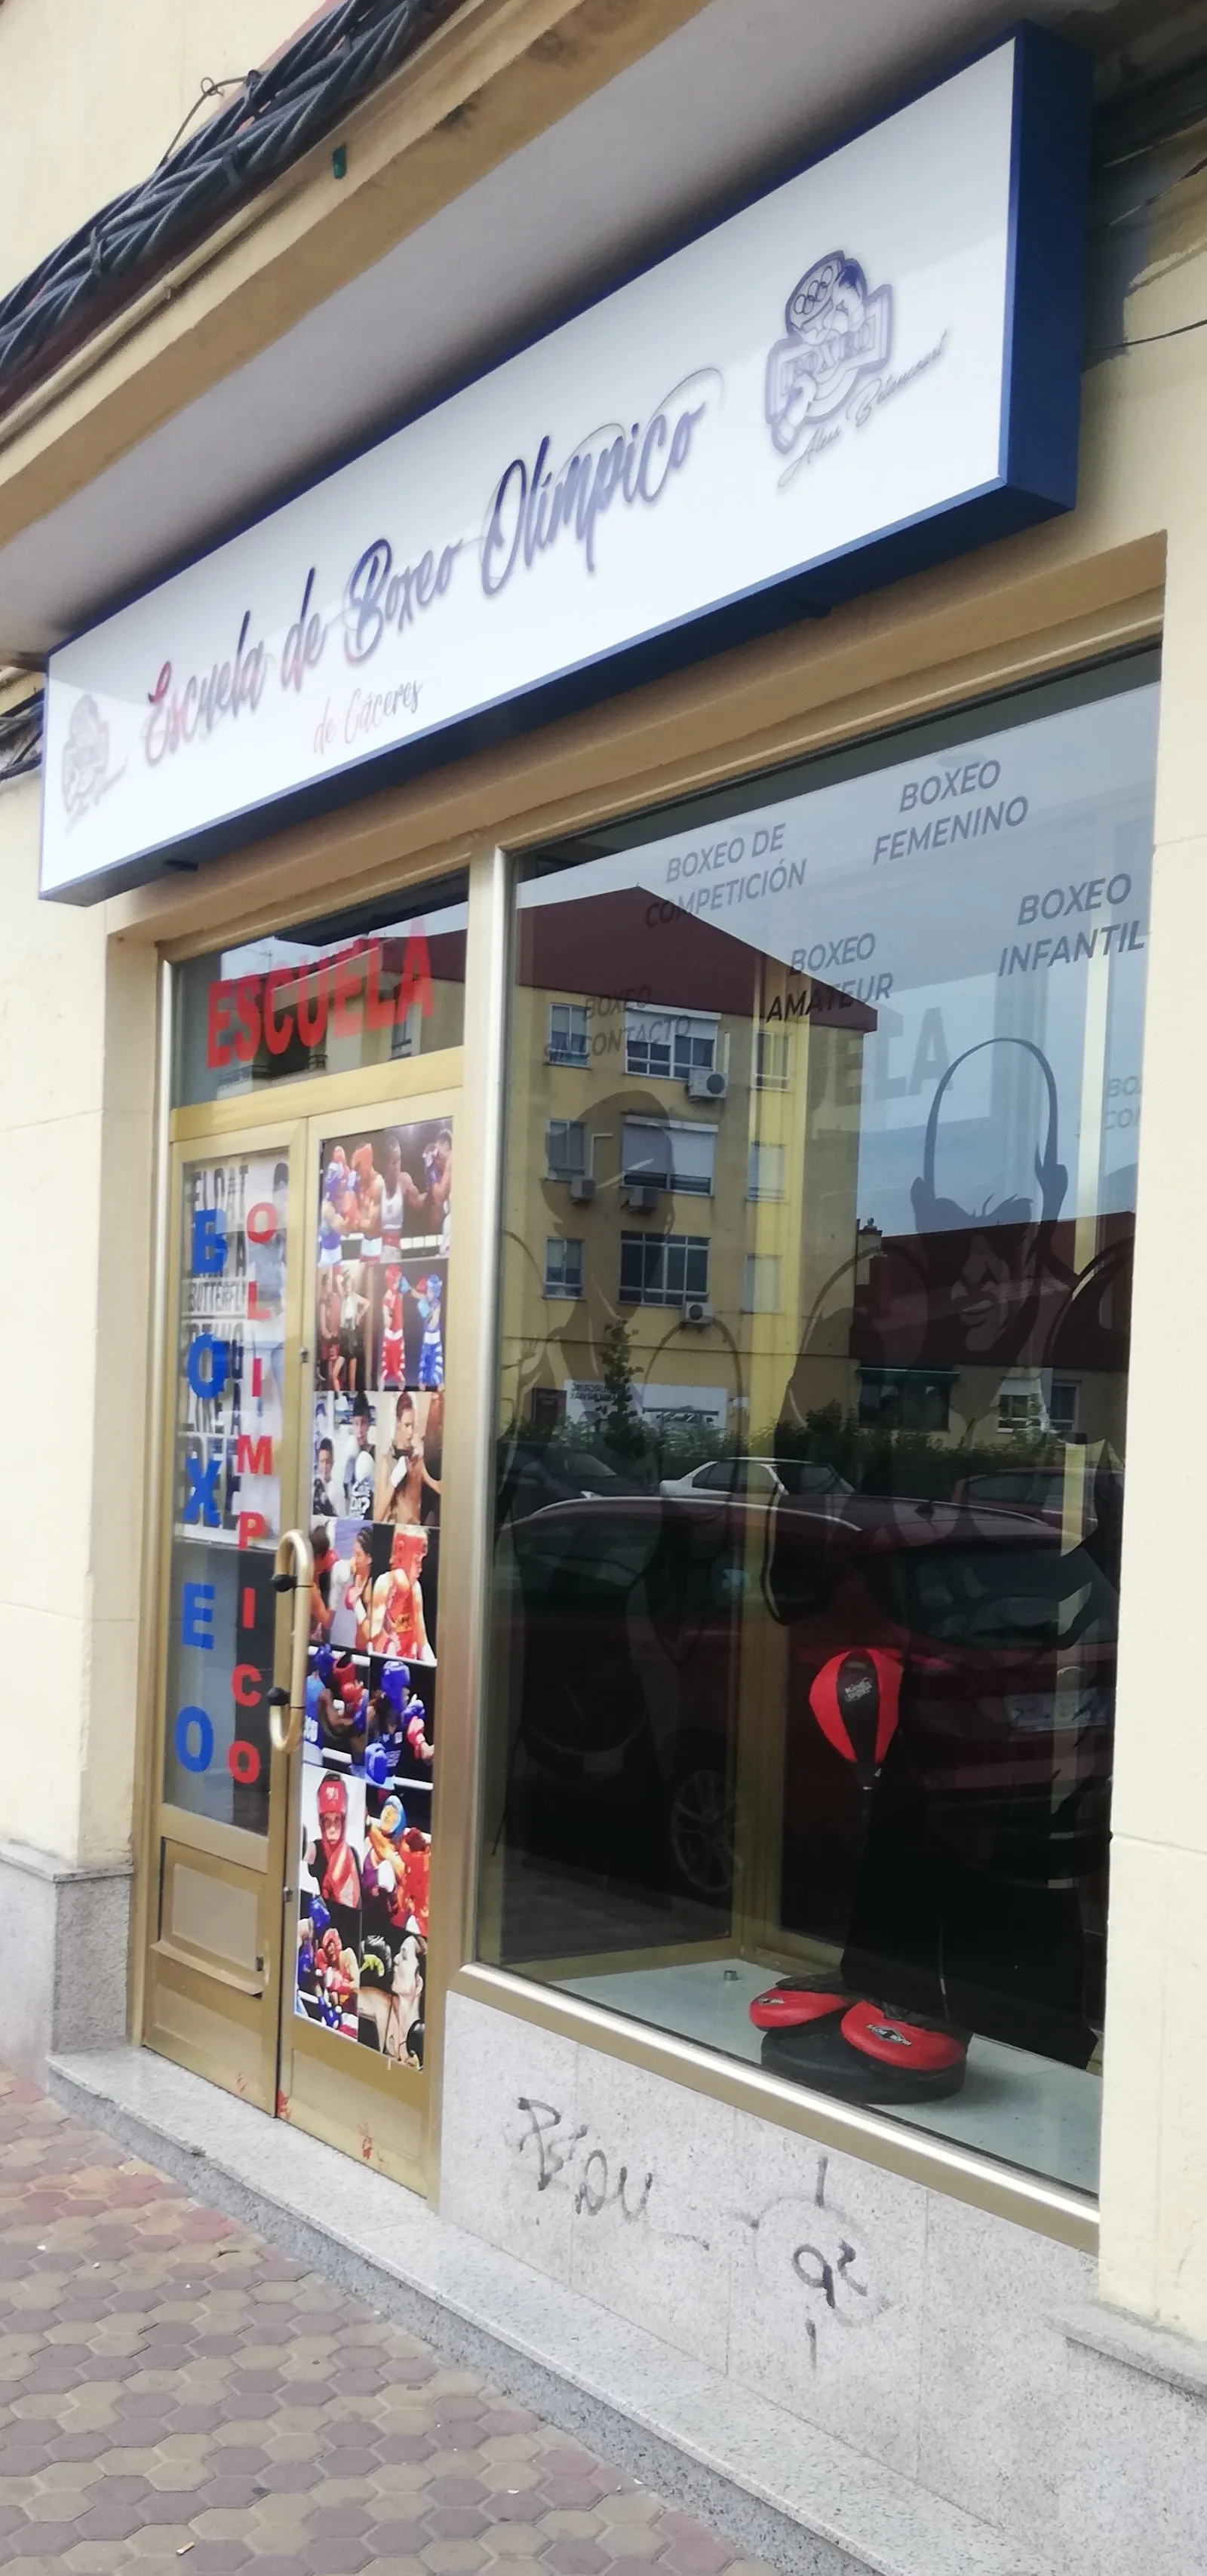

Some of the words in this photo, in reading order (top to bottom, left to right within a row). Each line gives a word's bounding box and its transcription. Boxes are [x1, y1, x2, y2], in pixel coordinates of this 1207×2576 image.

[141, 609, 270, 766] Escuela
[281, 566, 327, 692] de
[343, 538, 459, 664] Boxeo
[481, 385, 715, 597] Olímpico
[312, 695, 336, 755] de
[344, 679, 424, 745] Cáceres
[899, 759, 1002, 813] BOXEO
[665, 837, 746, 883] BOXEO
[751, 823, 786, 854] DE
[873, 795, 1029, 864] FEMENINO
[645, 858, 806, 929] COMPETICIÓN
[1017, 873, 1132, 926] BOXEO
[789, 932, 875, 977] BOXEO
[998, 920, 1145, 978] INFANTIL
[206, 917, 435, 1069] ESCUELA
[585, 984, 653, 1022] BOXEO
[766, 973, 894, 1024] AMATEUR
[176, 1207, 227, 1773] BOXEO
